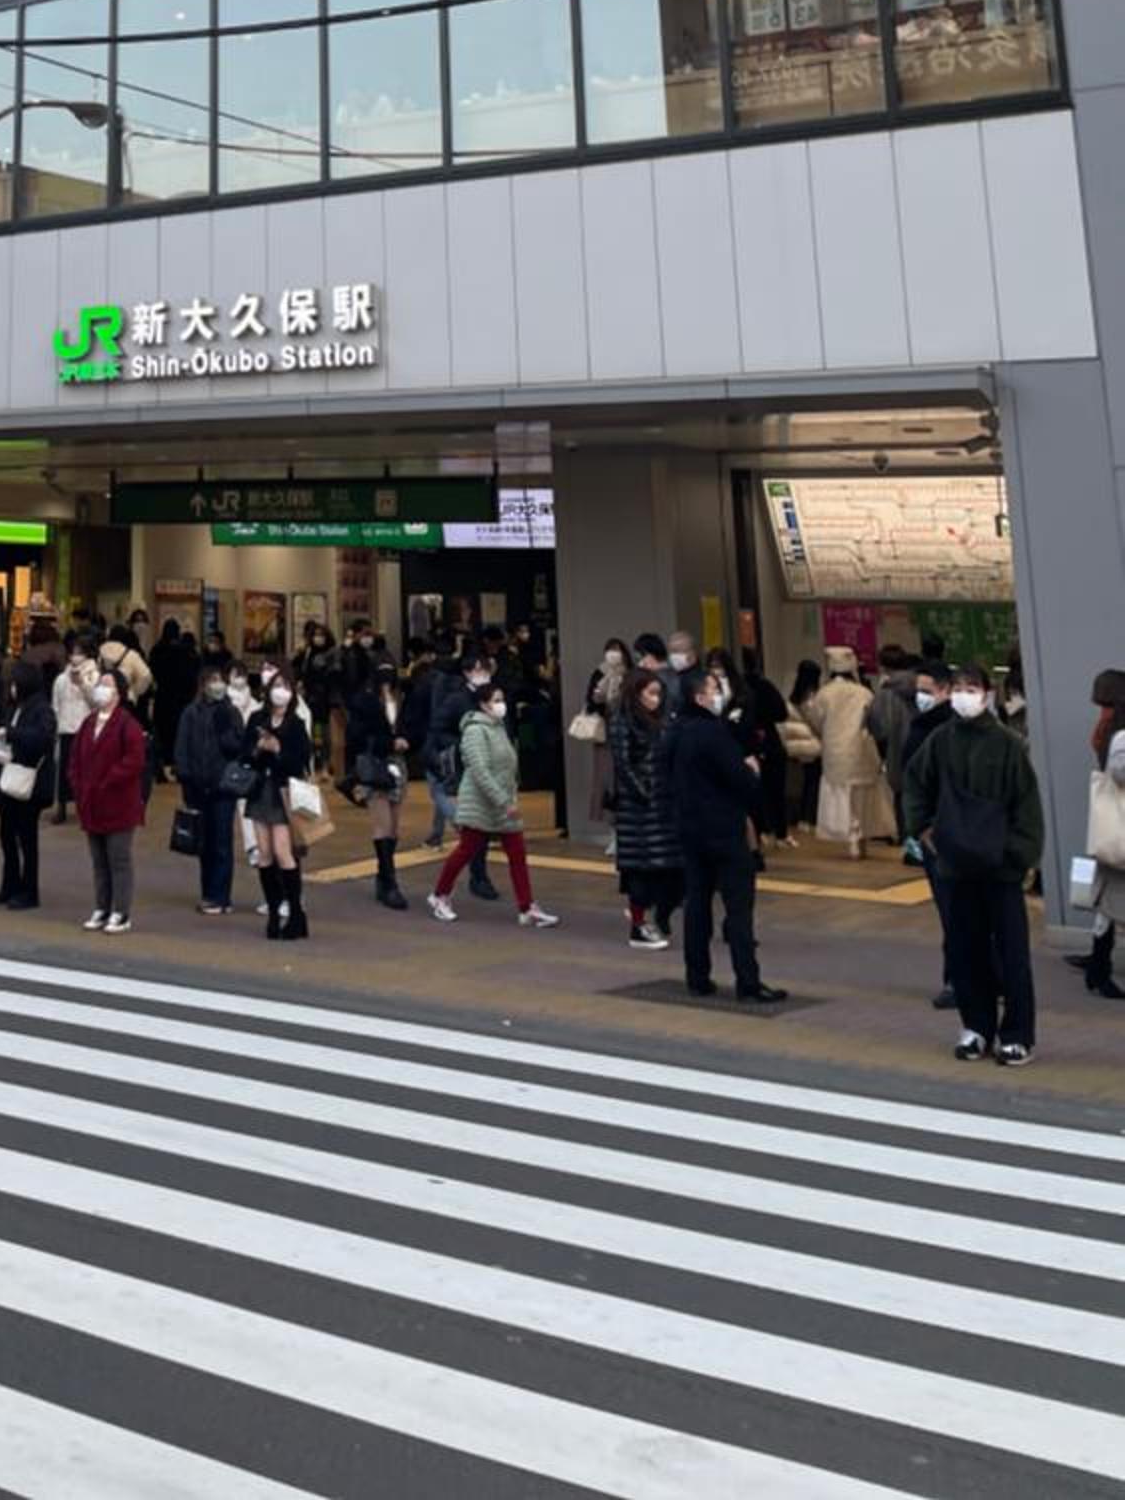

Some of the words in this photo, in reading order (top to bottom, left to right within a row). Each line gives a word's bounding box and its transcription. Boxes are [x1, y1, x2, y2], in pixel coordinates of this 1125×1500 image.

[53, 305, 123, 359] JR
[132, 284, 373, 344] 新大久保駅
[282, 342, 374, 370] Station
